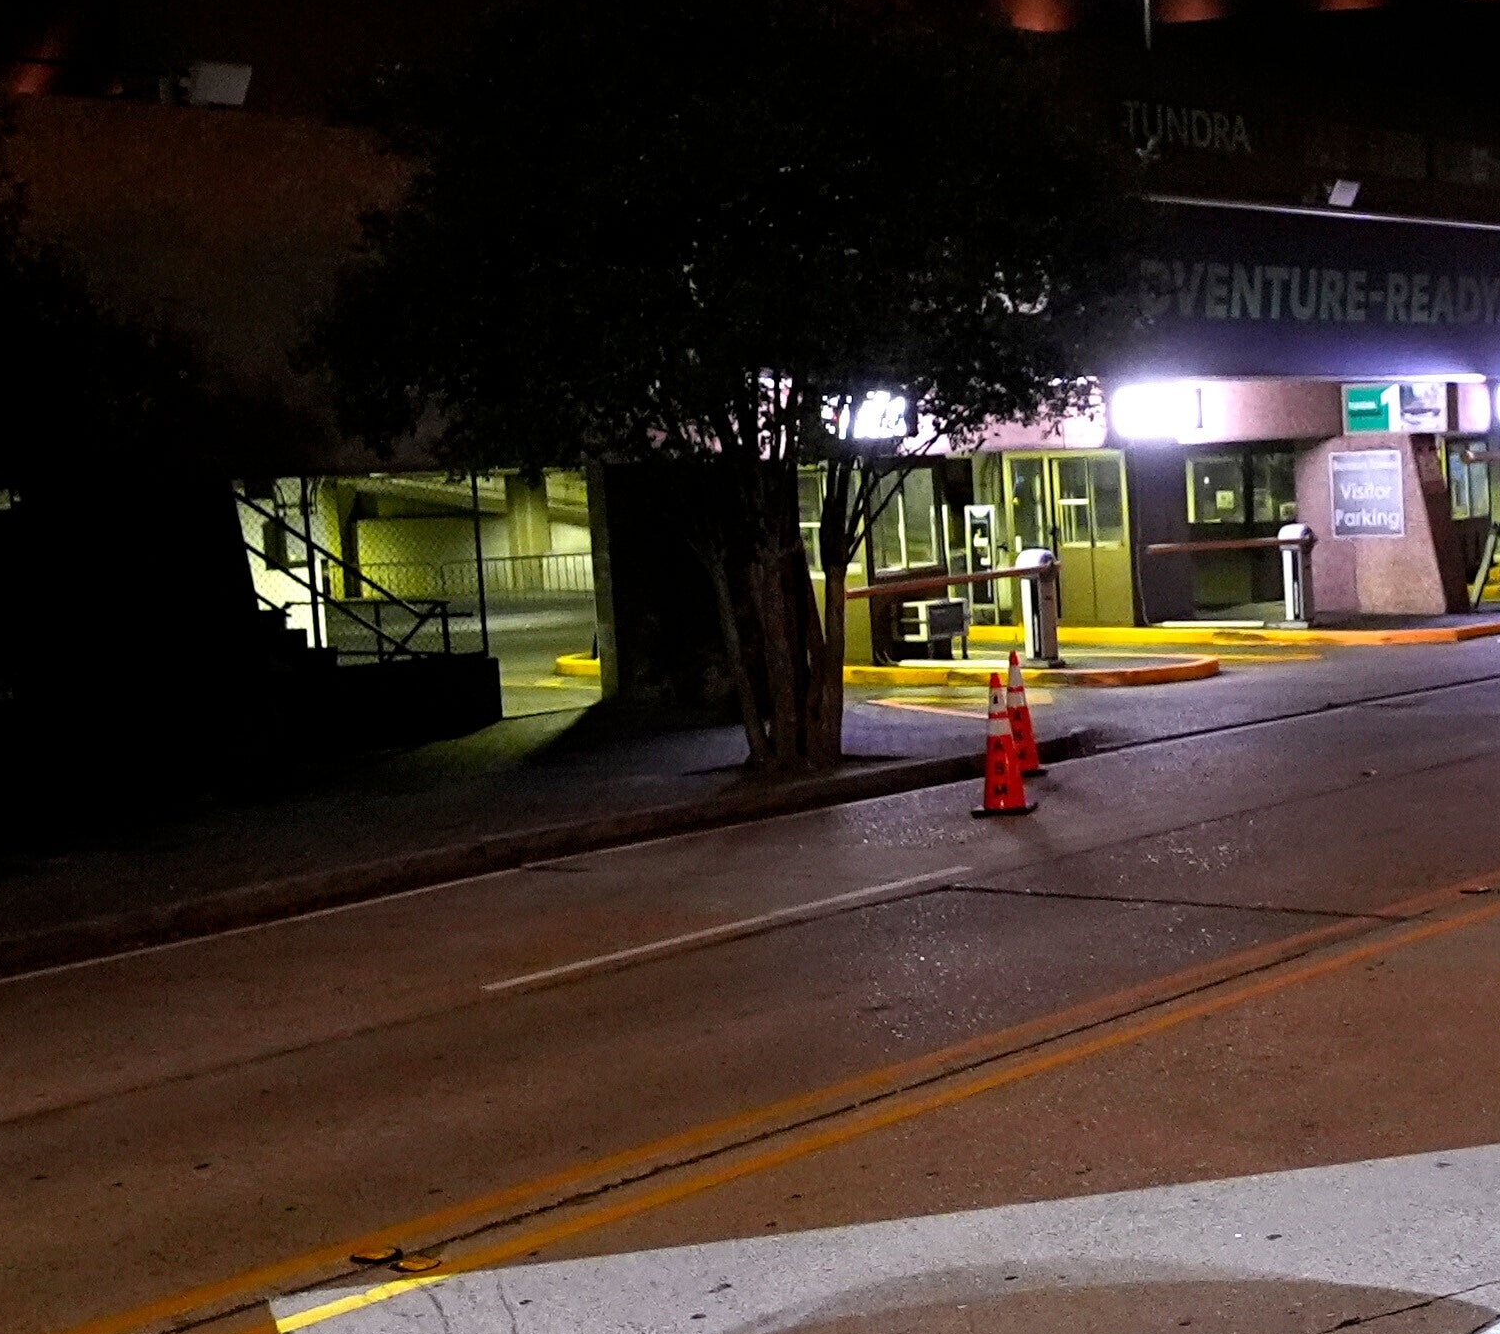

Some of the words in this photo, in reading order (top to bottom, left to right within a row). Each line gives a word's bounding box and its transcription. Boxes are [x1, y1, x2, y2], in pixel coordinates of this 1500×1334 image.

[1122, 100, 1252, 154] TUNDRA
[1340, 482, 1391, 501] Visitor
[1335, 509, 1402, 530] Parking
